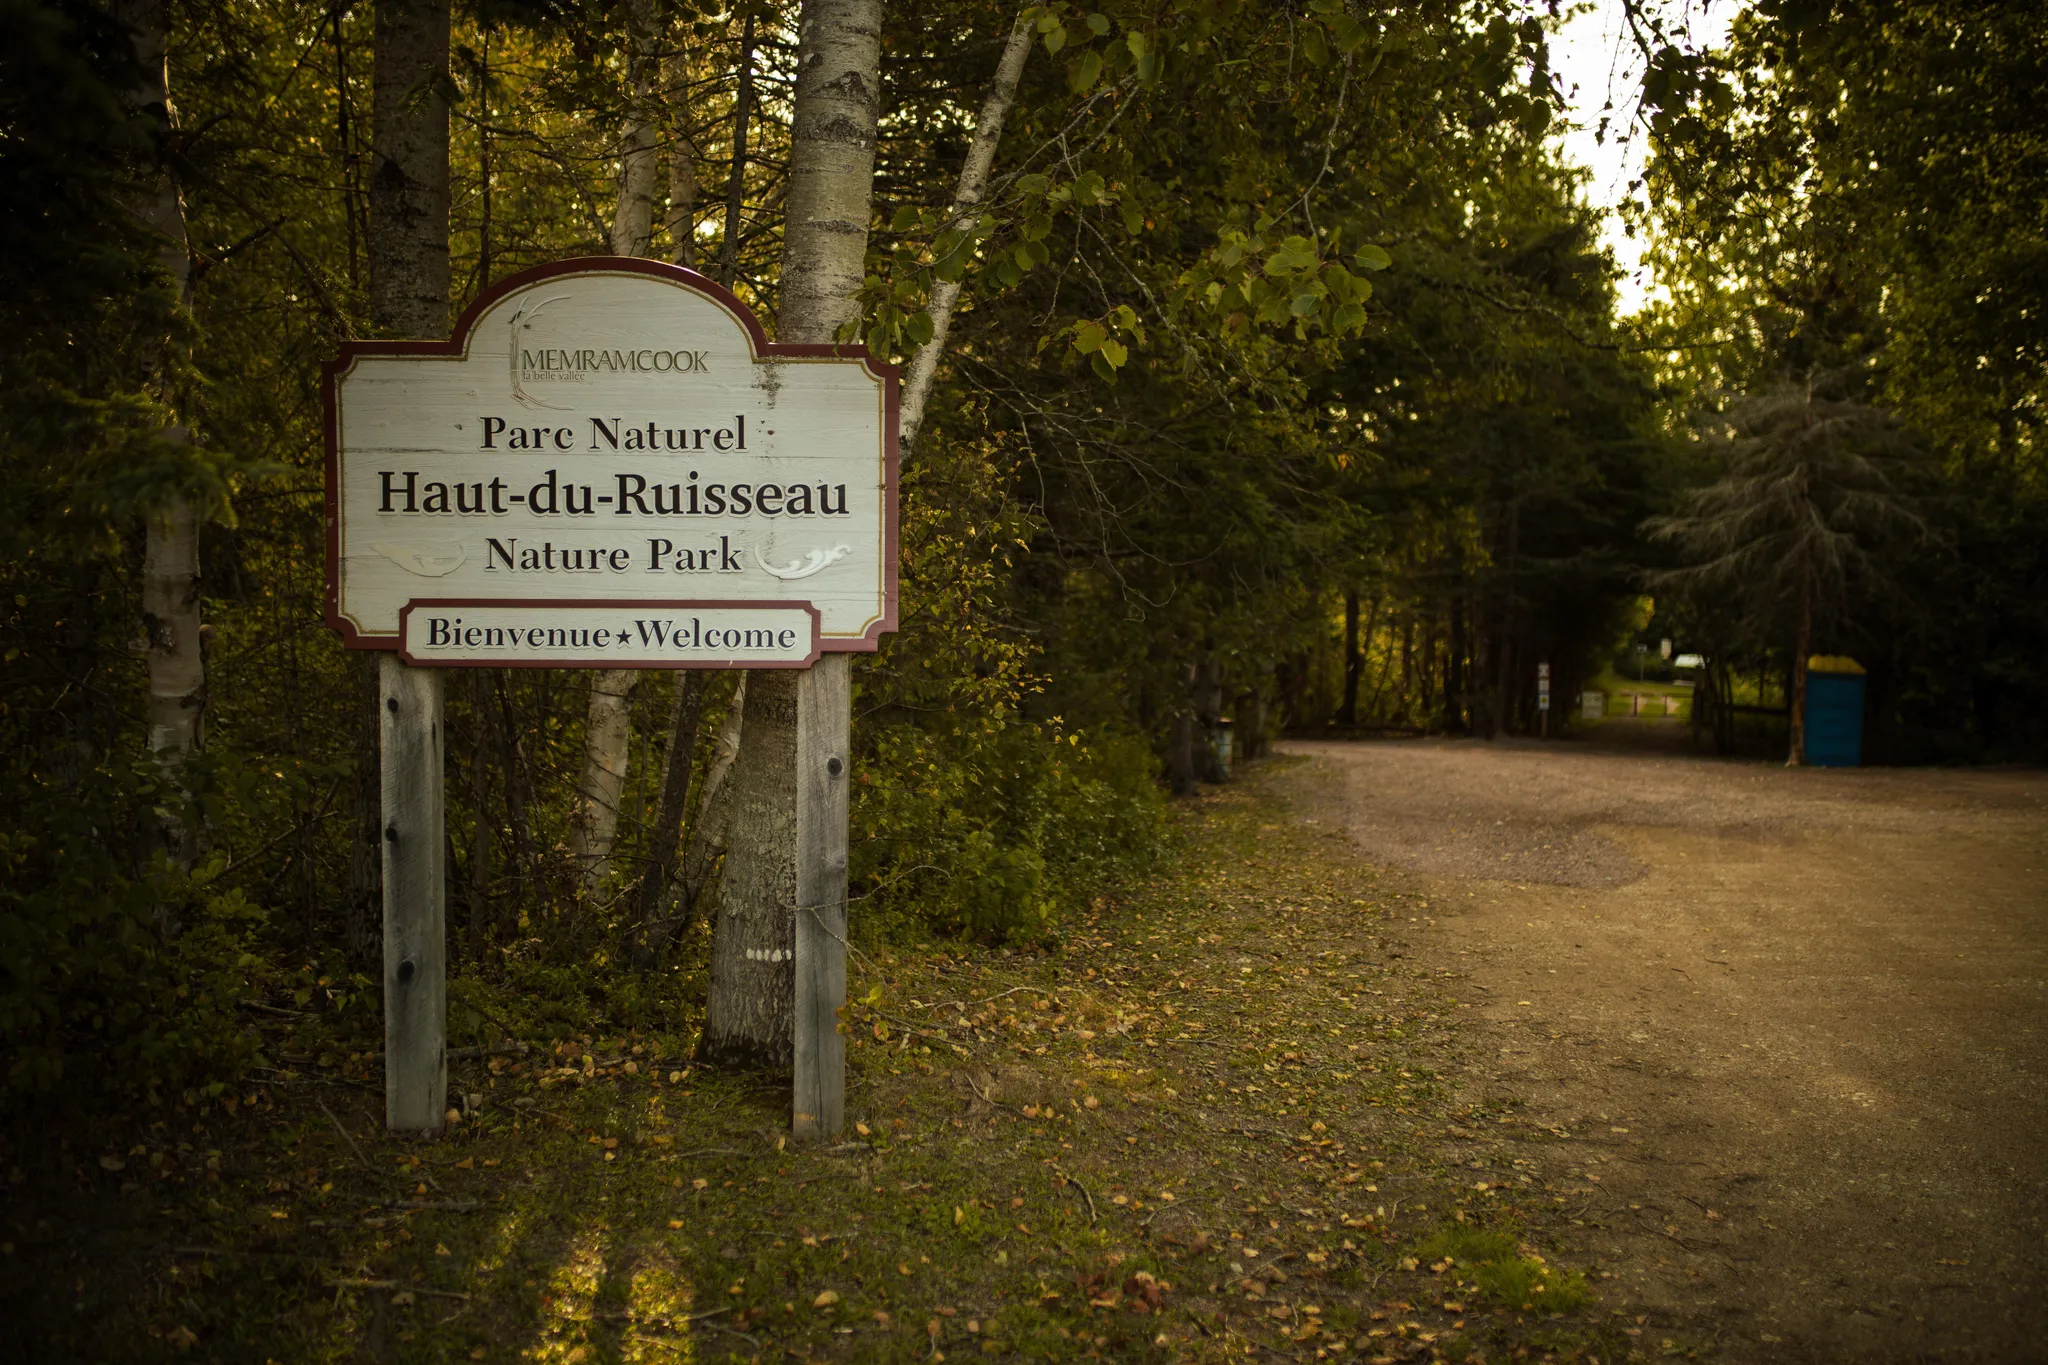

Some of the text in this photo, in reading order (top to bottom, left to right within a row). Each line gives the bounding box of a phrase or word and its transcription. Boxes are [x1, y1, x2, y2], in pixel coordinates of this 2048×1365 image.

[522, 349, 710, 372] MEMRAMCOOK
[523, 371, 585, 381] la belle vallée
[480, 415, 747, 450] Parc Naturel
[377, 469, 849, 515] Haut-du-Ruisseau
[485, 536, 742, 571] Nature Park
[427, 618, 796, 649] Bienvenue Welcome
